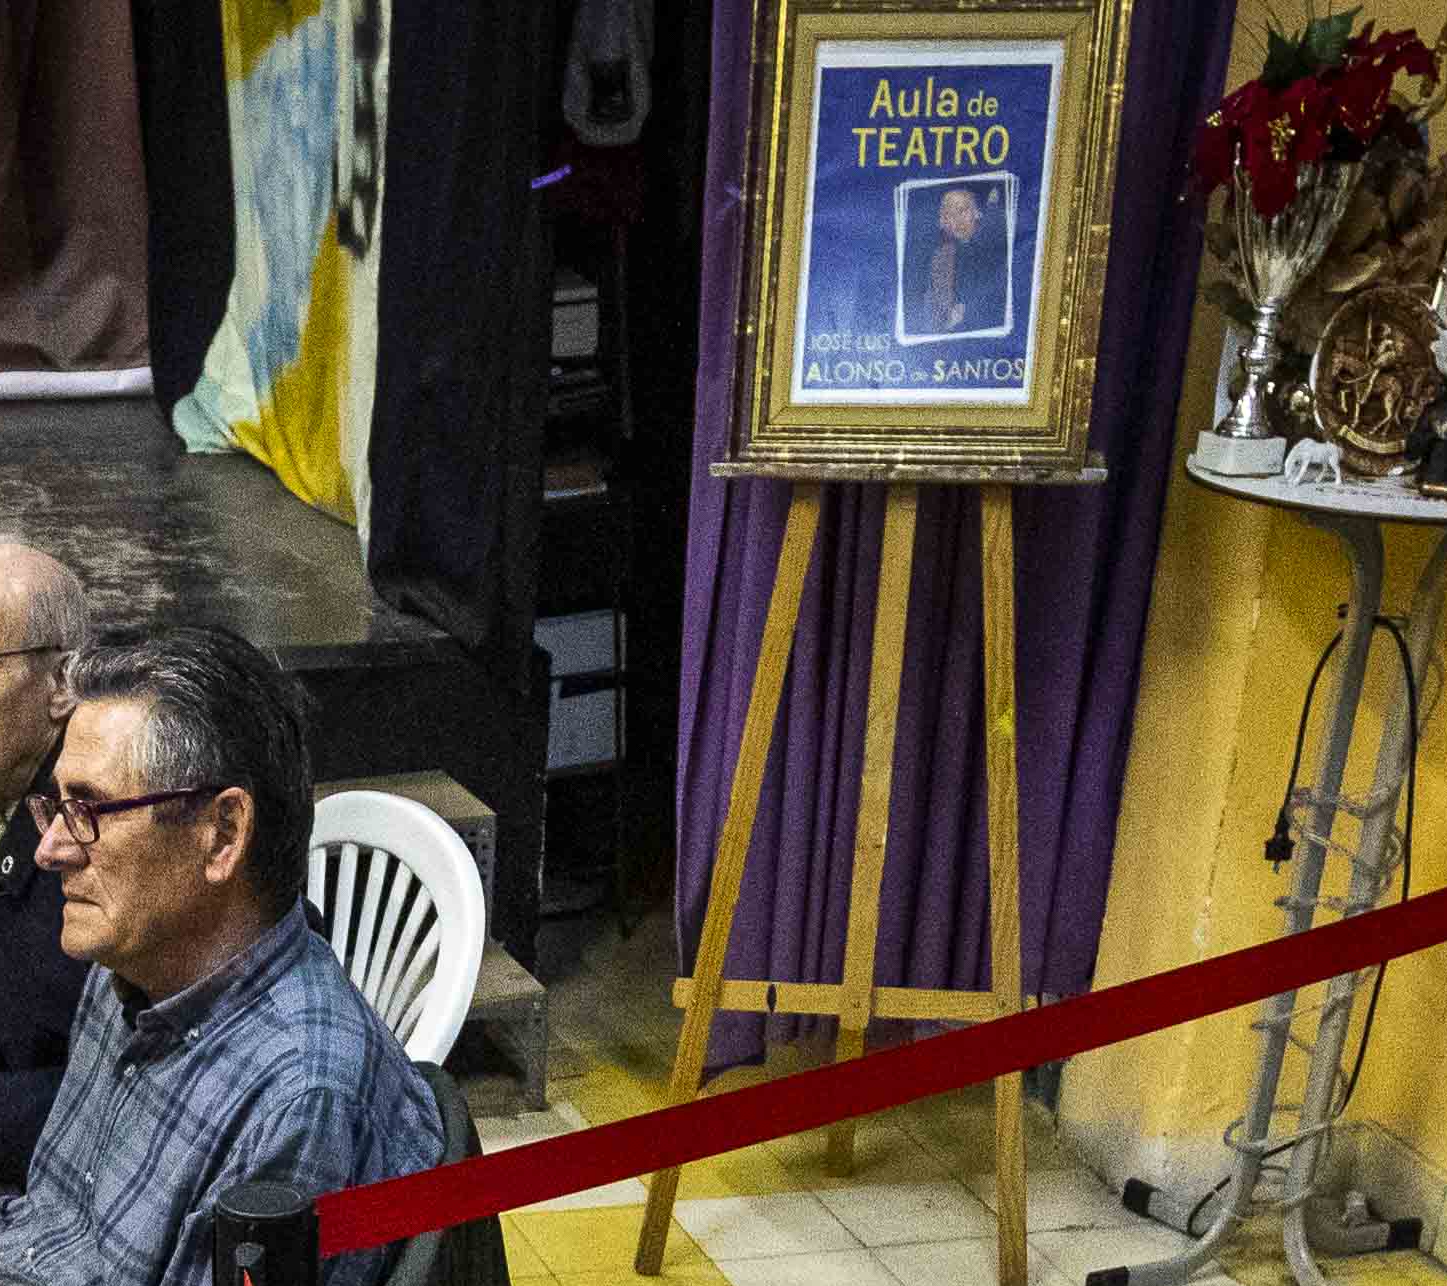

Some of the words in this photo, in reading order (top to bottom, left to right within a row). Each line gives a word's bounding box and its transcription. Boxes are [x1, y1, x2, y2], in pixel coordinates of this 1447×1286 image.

[868, 76, 959, 118] Aula
[967, 90, 999, 117] de
[851, 125, 1010, 168] TEATRO
[805, 360, 906, 383] ALONSO
[933, 358, 1024, 382] SANTOS
